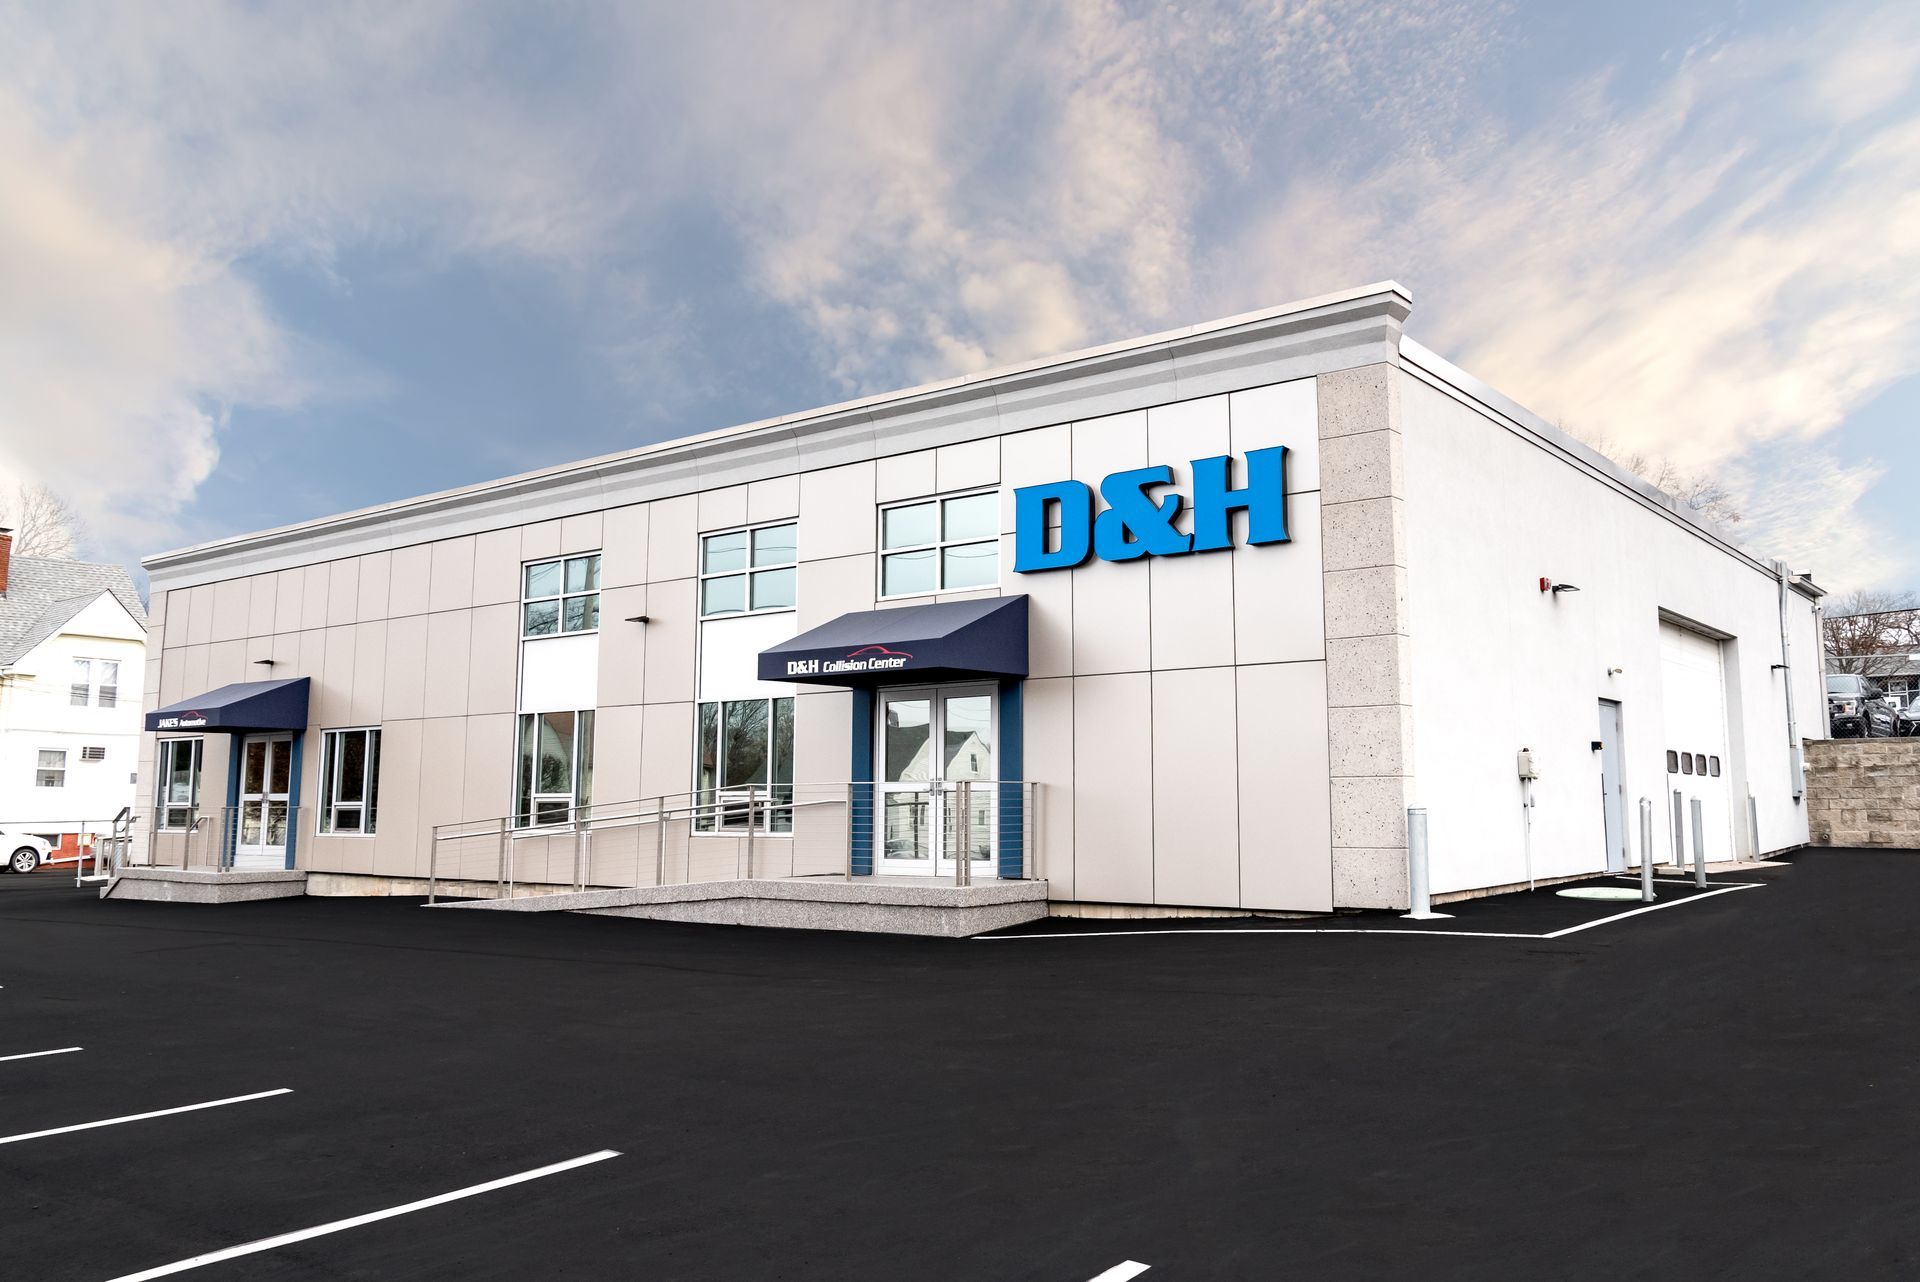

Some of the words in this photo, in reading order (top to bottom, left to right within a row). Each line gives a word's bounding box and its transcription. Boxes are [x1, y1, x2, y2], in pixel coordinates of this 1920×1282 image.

[1013, 445, 1291, 573] D&H
[787, 659, 819, 675] D&H
[822, 659, 867, 673] Collision
[867, 657, 906, 670] Center
